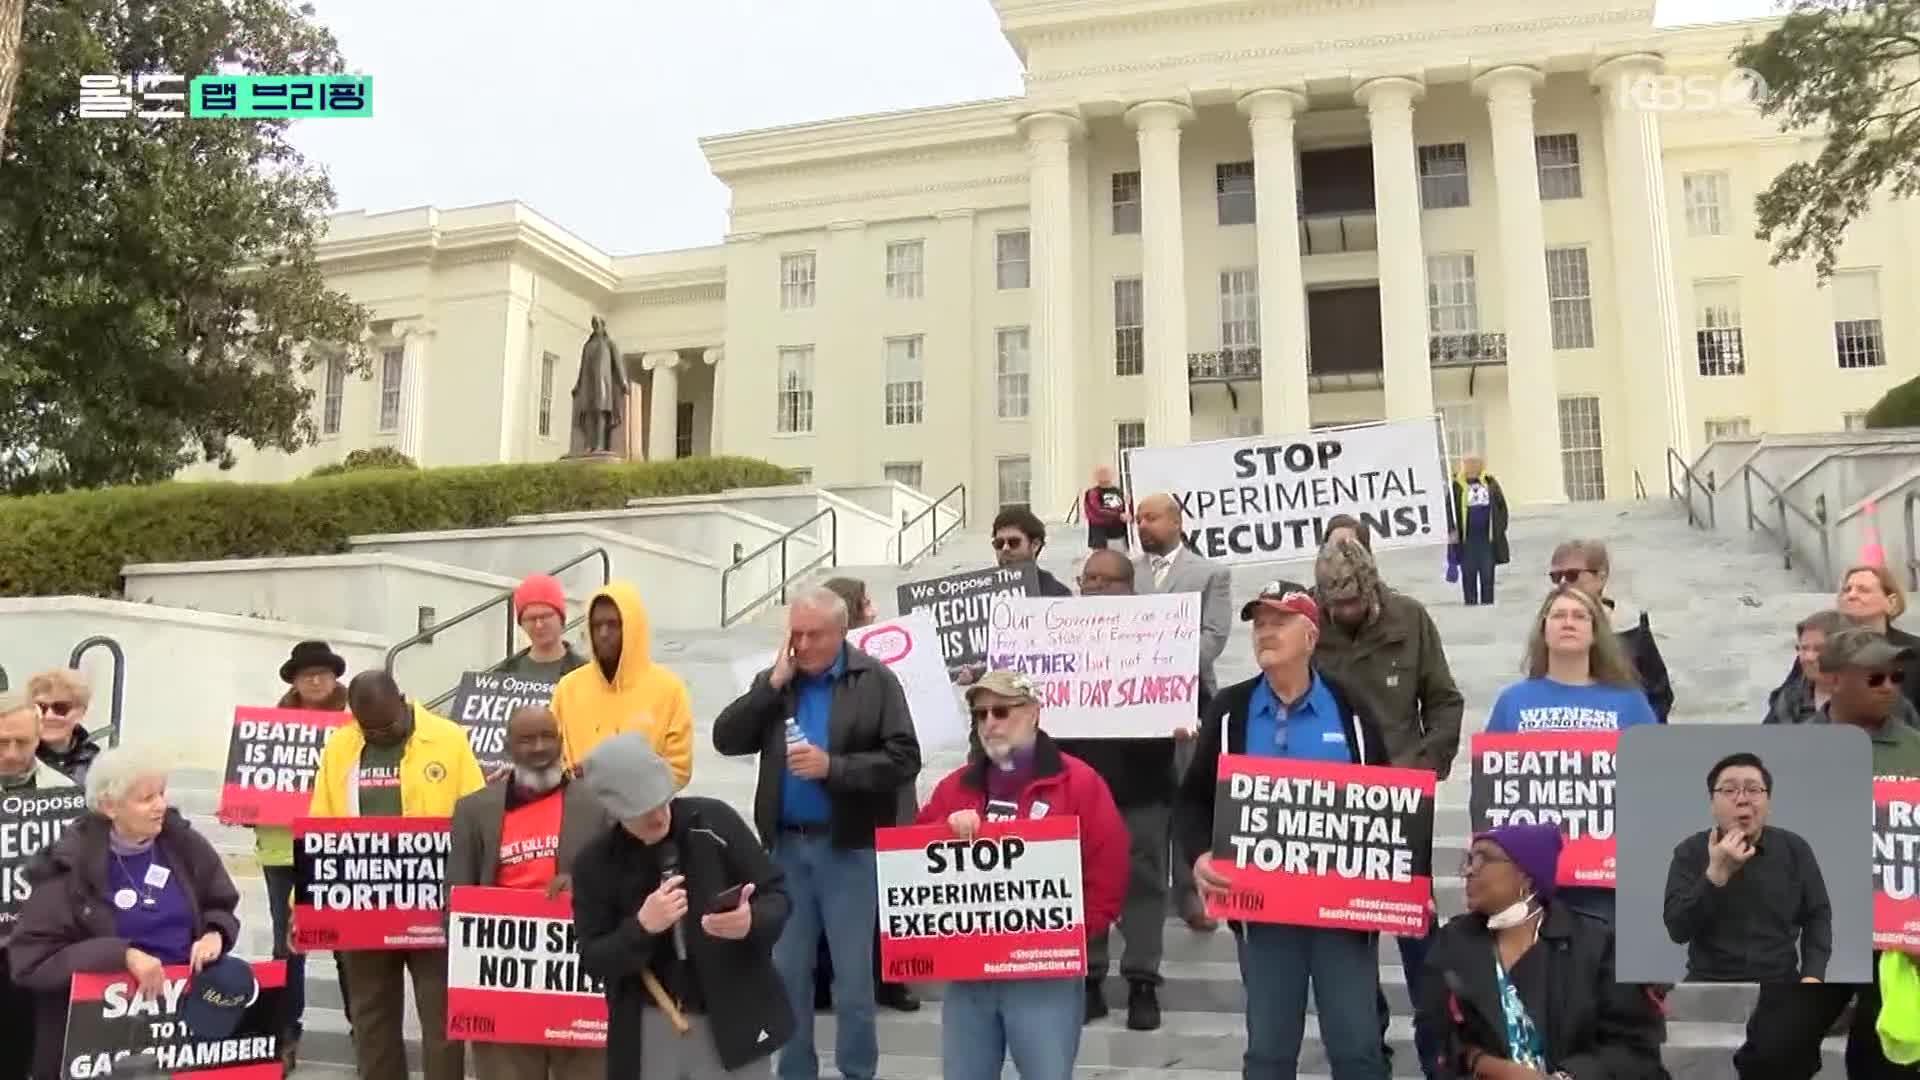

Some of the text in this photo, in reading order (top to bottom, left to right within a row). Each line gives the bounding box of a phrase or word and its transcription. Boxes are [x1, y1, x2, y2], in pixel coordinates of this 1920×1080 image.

[1233, 441, 1342, 479] STOP
[1173, 467, 1426, 519] XPERIMENTAL
[1182, 505, 1431, 559] XECUTINS!
[911, 568, 1022, 599] We Oppose The
[992, 600, 1034, 631] Our
[475, 675, 499, 689] We
[1040, 680, 1070, 711] ERN
[1079, 678, 1113, 706] DAY
[239, 721, 317, 743] DEATH
[245, 744, 323, 767] IS MEN
[1482, 750, 1616, 775] DEATH R
[236, 766, 316, 793] TORT
[1230, 773, 1422, 814] DEATH ROW
[1494, 780, 1616, 805] IS MENT
[3, 796, 85, 816] Oppose
[1240, 805, 1407, 845] IS MENTAL
[304, 832, 389, 854] DEATH
[545, 835, 559, 849] FO
[926, 838, 1025, 874] STOP
[1872, 832, 1920, 861] NT
[314, 858, 337, 880] IS
[1230, 835, 1413, 883] TORTURE
[307, 883, 444, 911] TORTUR
[887, 878, 1072, 907] EXPERIMENTAL
[459, 917, 537, 952] THOU
[889, 906, 1073, 938] EXECUTIONS!
[479, 955, 537, 988] NOT
[889, 958, 934, 976] ACTION
[103, 978, 187, 1019] SAY
[149, 1022, 174, 1038] TO
[140, 1036, 276, 1070] HAMBER!
